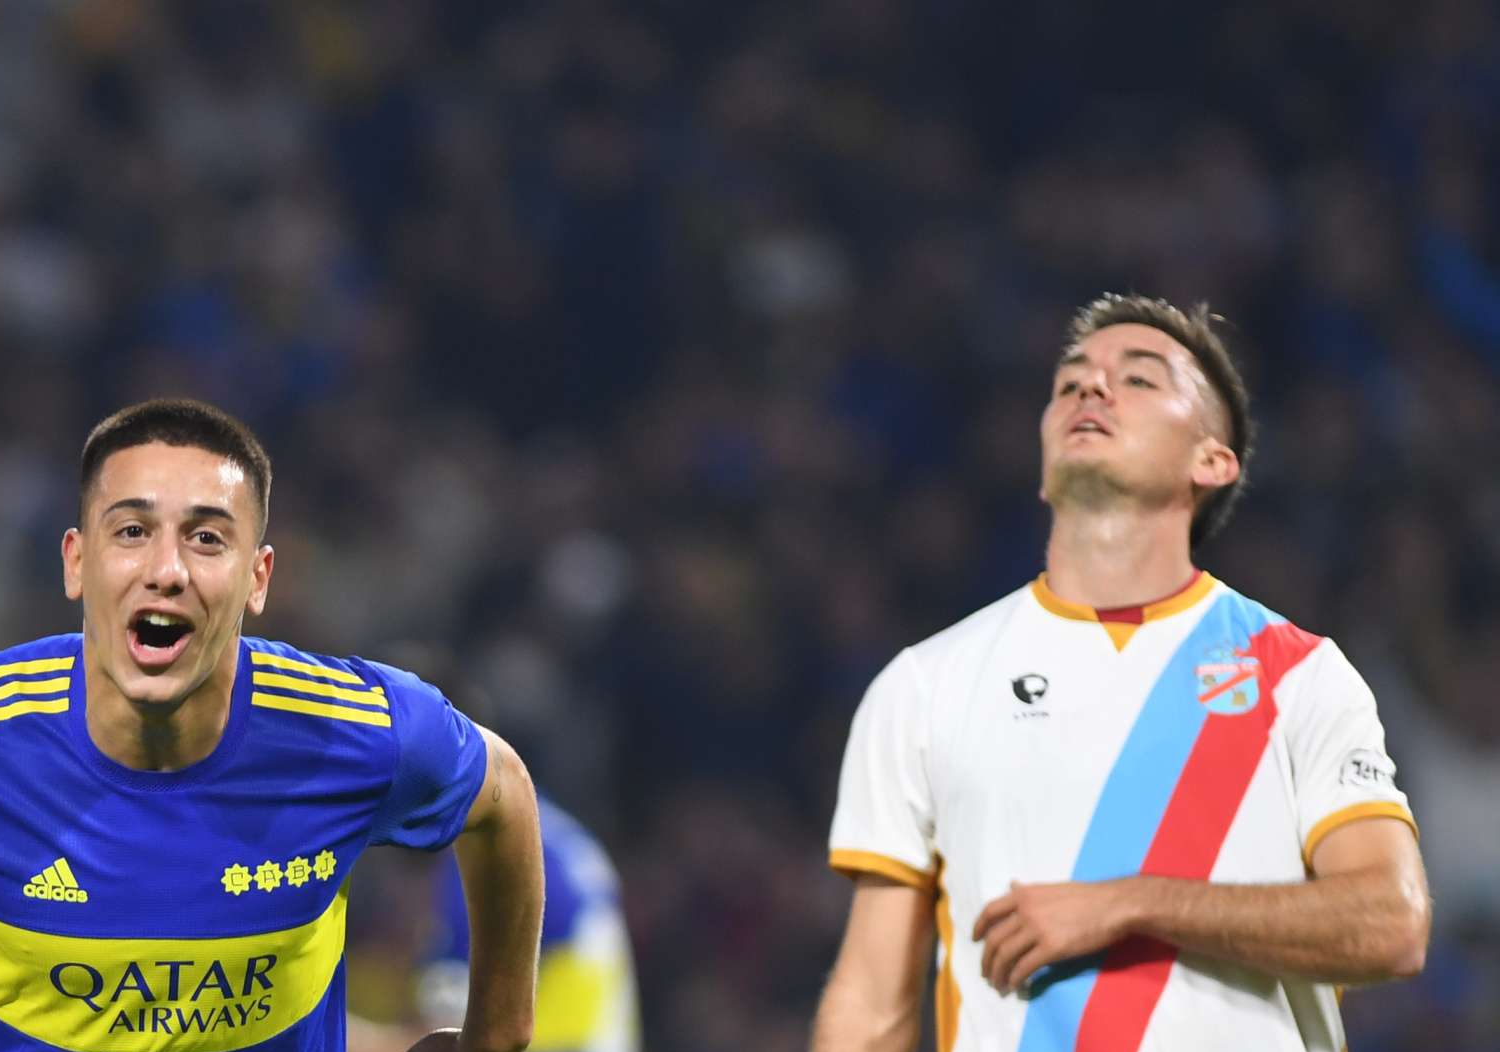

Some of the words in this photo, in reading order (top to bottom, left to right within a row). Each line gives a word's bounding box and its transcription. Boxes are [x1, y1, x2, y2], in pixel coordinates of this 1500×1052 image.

[23, 882, 88, 903] adidas
[50, 954, 277, 1013] QATAR
[108, 994, 272, 1035] AIRWAYS
